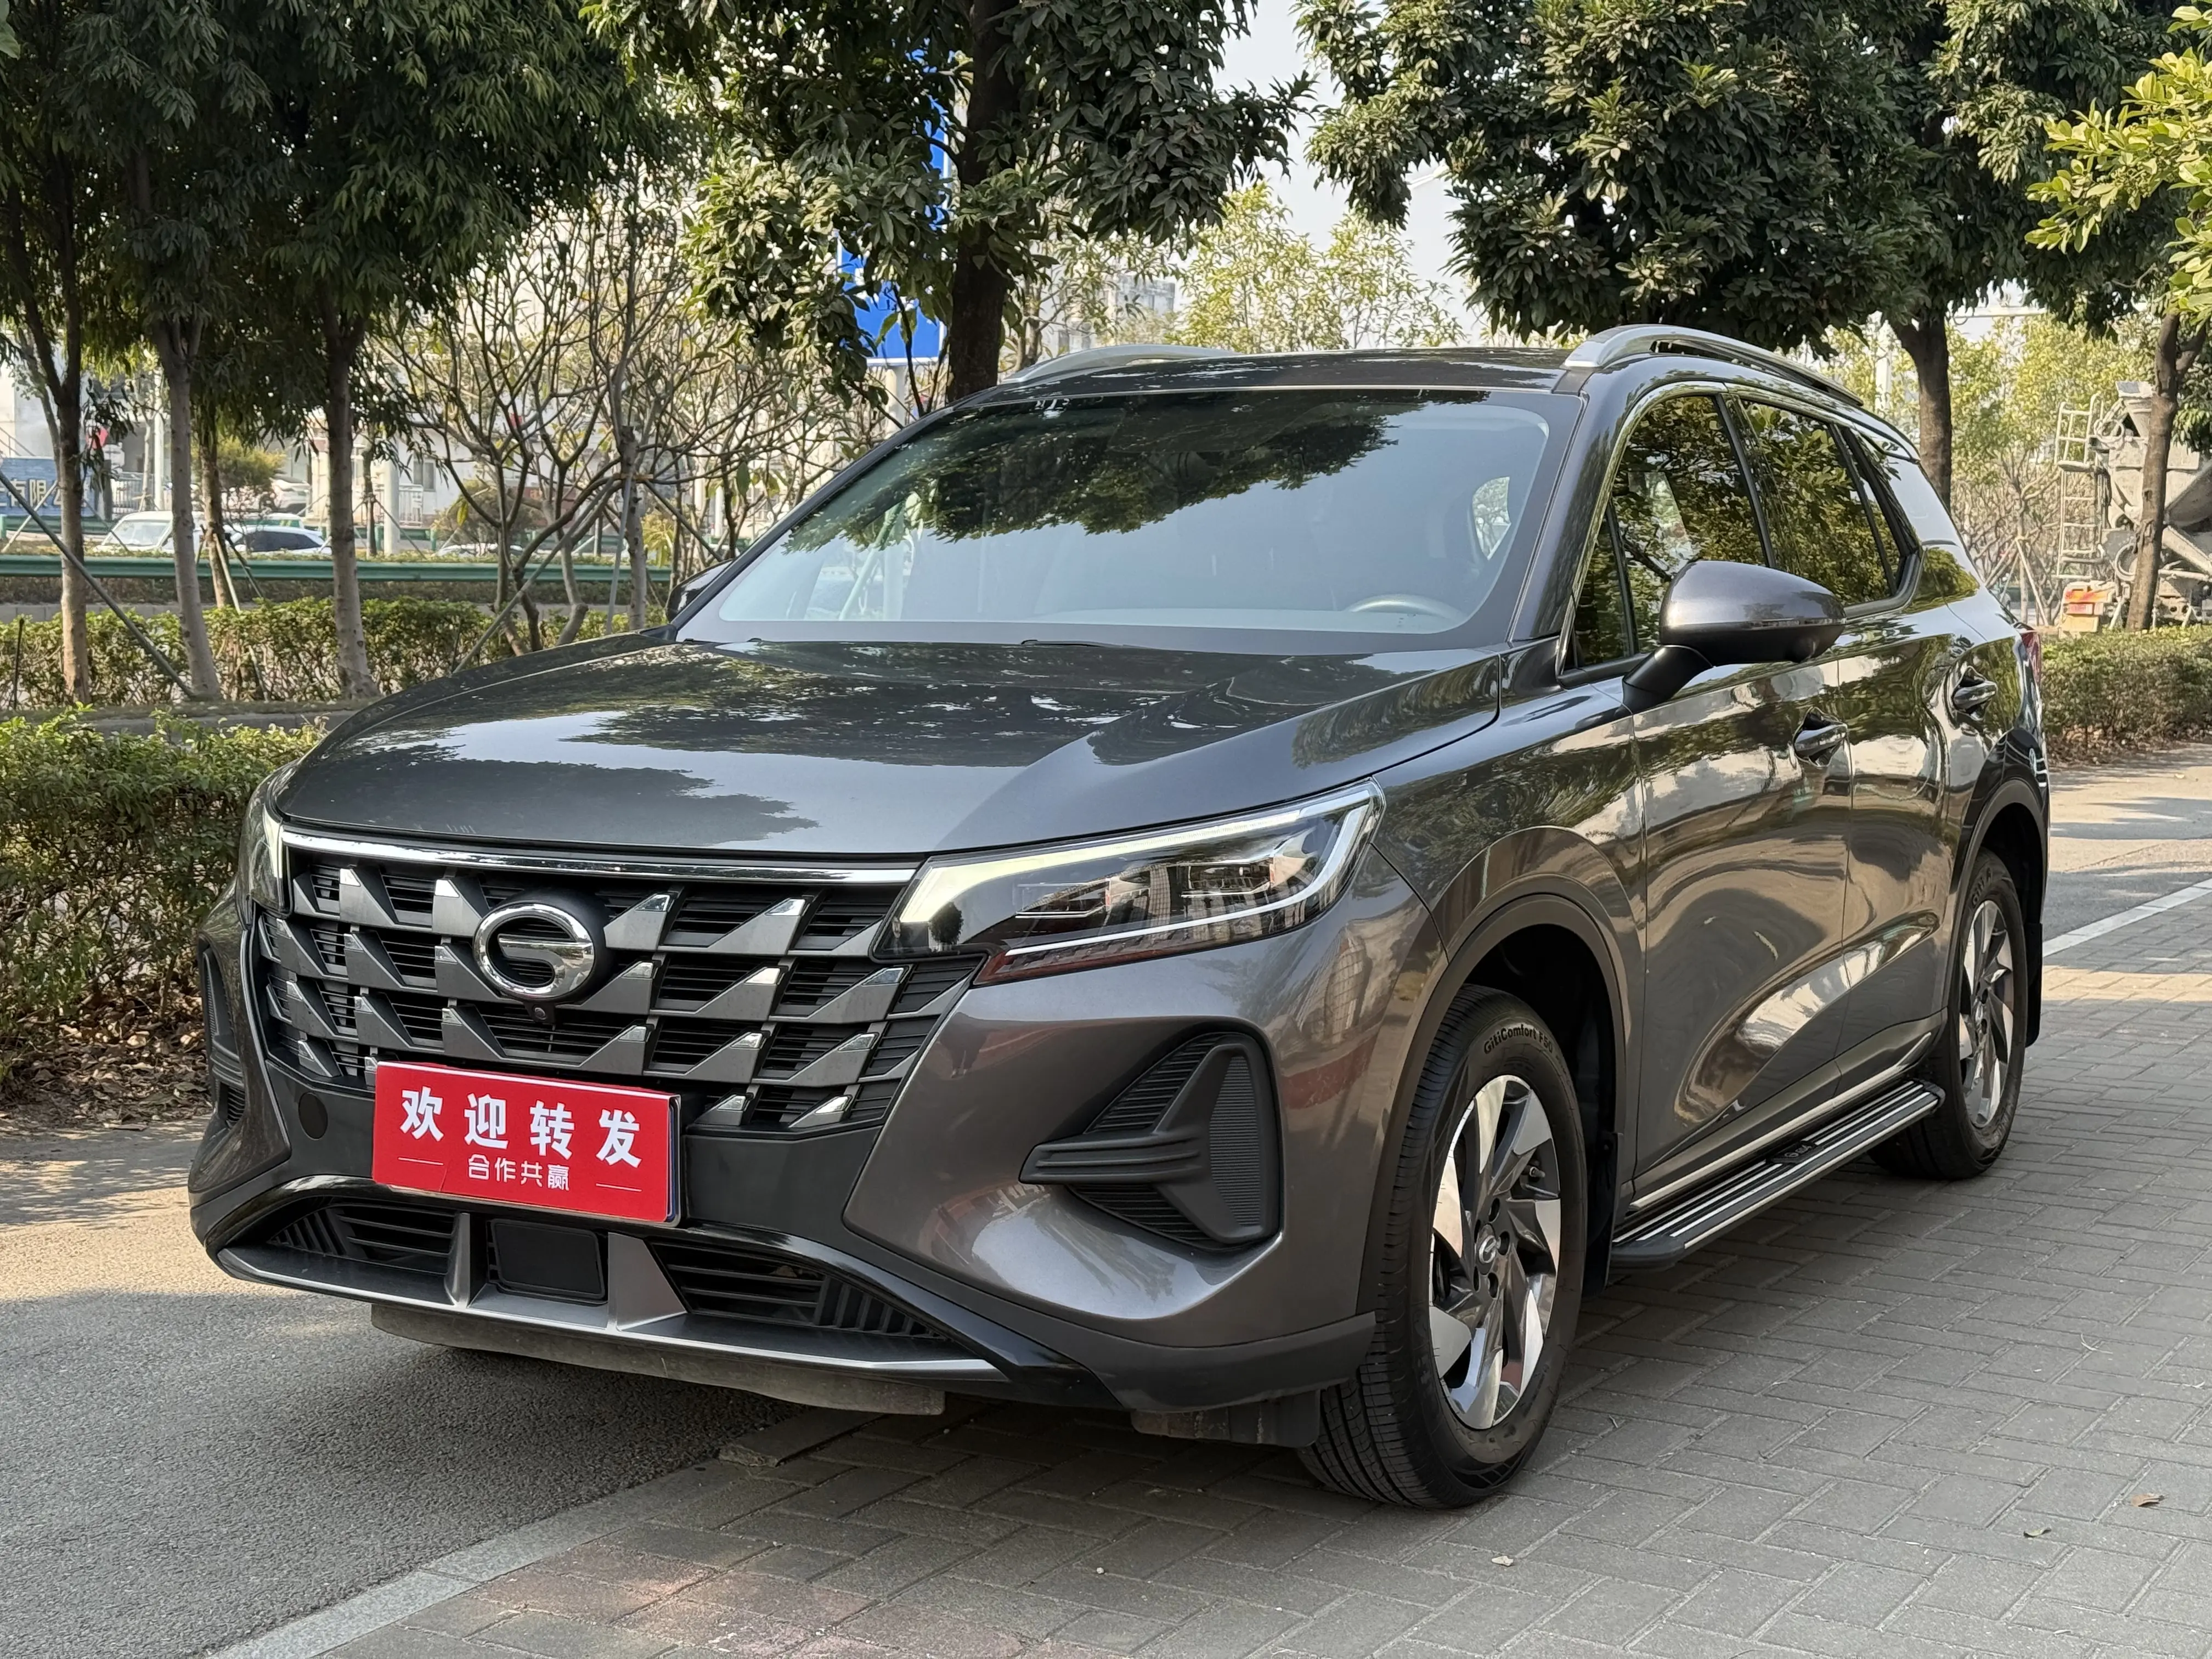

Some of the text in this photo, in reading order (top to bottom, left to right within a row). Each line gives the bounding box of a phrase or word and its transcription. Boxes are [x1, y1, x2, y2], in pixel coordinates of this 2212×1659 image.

[1484, 1024, 1537, 1054] GitiComfort
[399, 1086, 643, 1169] 欢迎转发
[467, 1154, 571, 1191] 合作共赢
